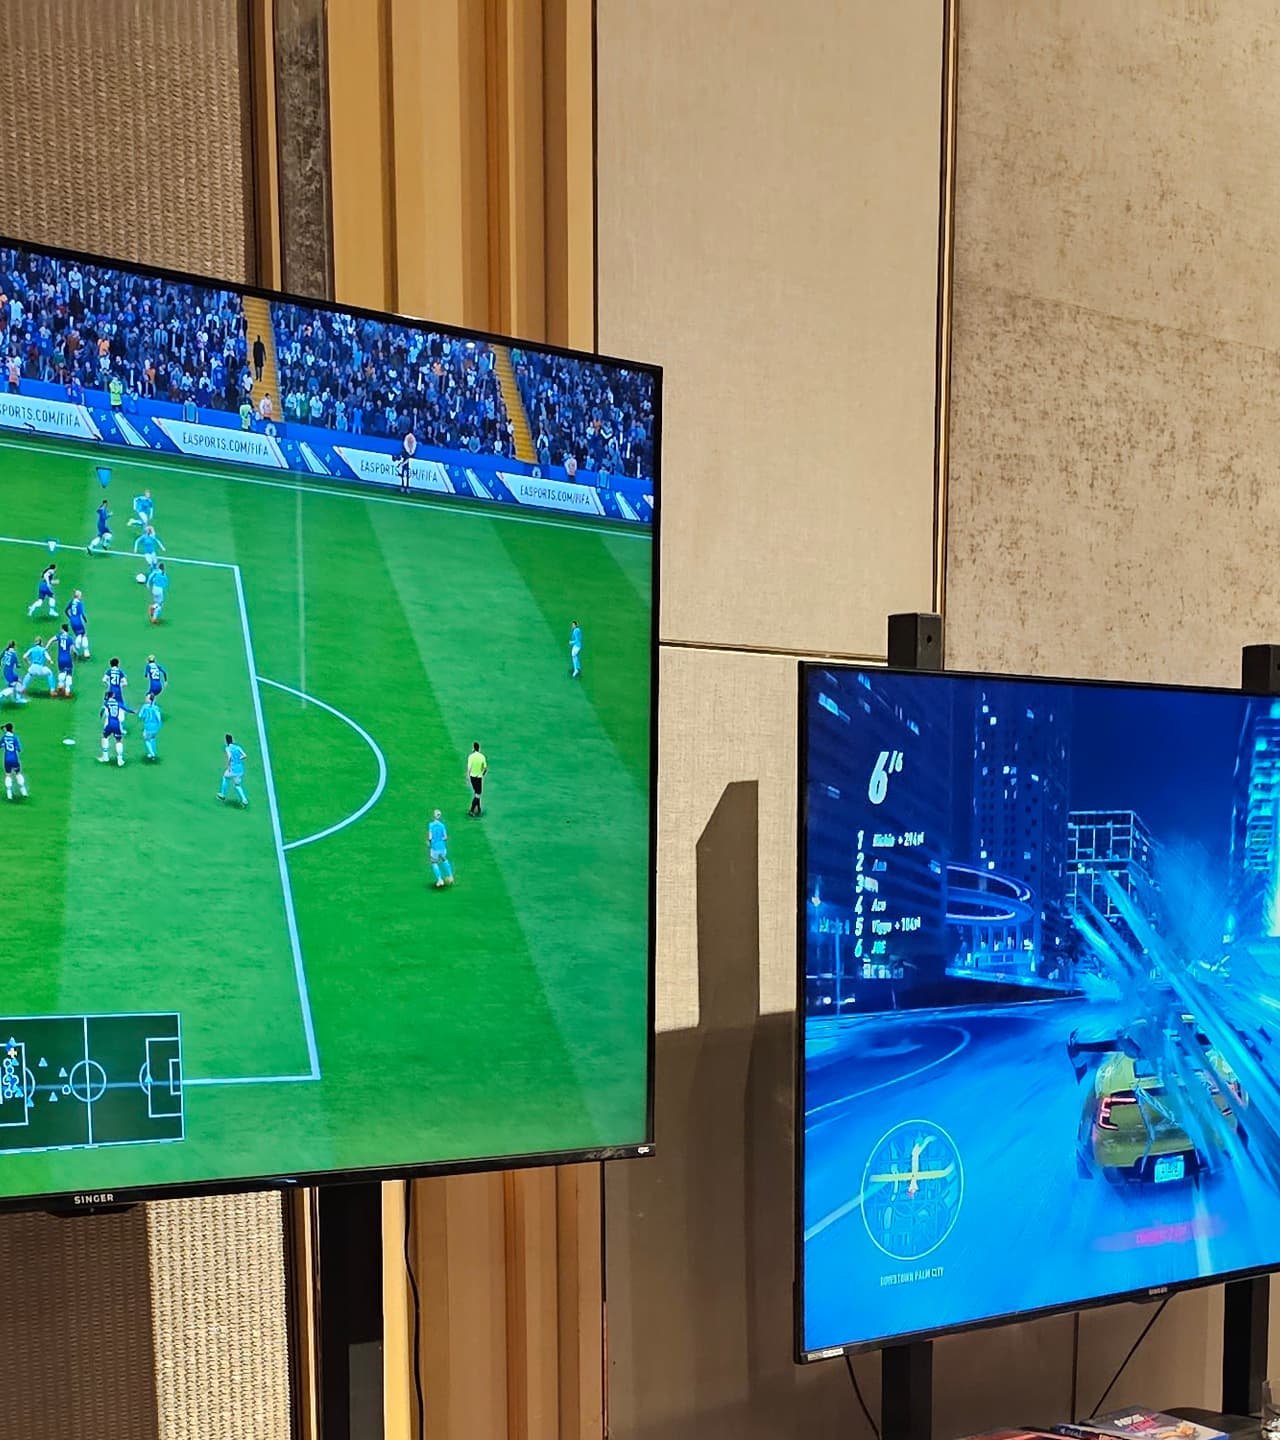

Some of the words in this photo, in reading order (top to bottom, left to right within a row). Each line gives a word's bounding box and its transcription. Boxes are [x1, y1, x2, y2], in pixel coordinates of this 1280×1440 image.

[183, 432, 269, 457] EASPORTS.COM/FIFA
[855, 852, 865, 872] 2
[855, 917, 865, 936] 5
[74, 1193, 114, 1204] SINGER
